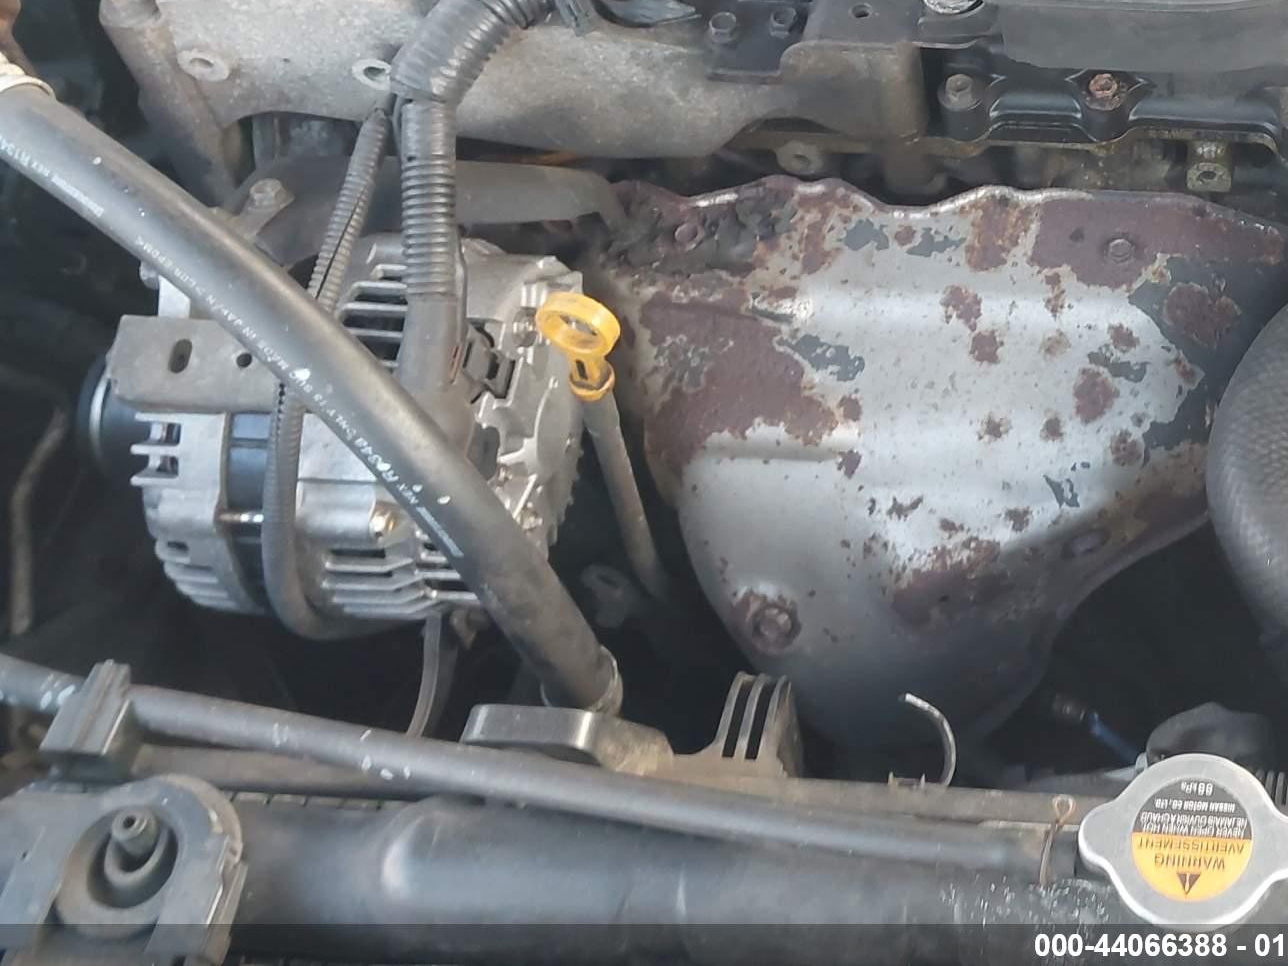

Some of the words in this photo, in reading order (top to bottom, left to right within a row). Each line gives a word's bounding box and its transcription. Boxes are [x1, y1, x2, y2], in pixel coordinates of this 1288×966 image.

[1184, 800, 1208, 812] MOTOR
[1209, 802, 1236, 813] NISSAN
[1208, 816, 1236, 828] JAMAIS
[1162, 824, 1189, 836] WHEN
[1191, 826, 1214, 837] OPEN
[1216, 828, 1244, 838] NEVER
[1137, 837, 1244, 855] AVERTISSEMENT
[1154, 853, 1226, 871] WARNING
